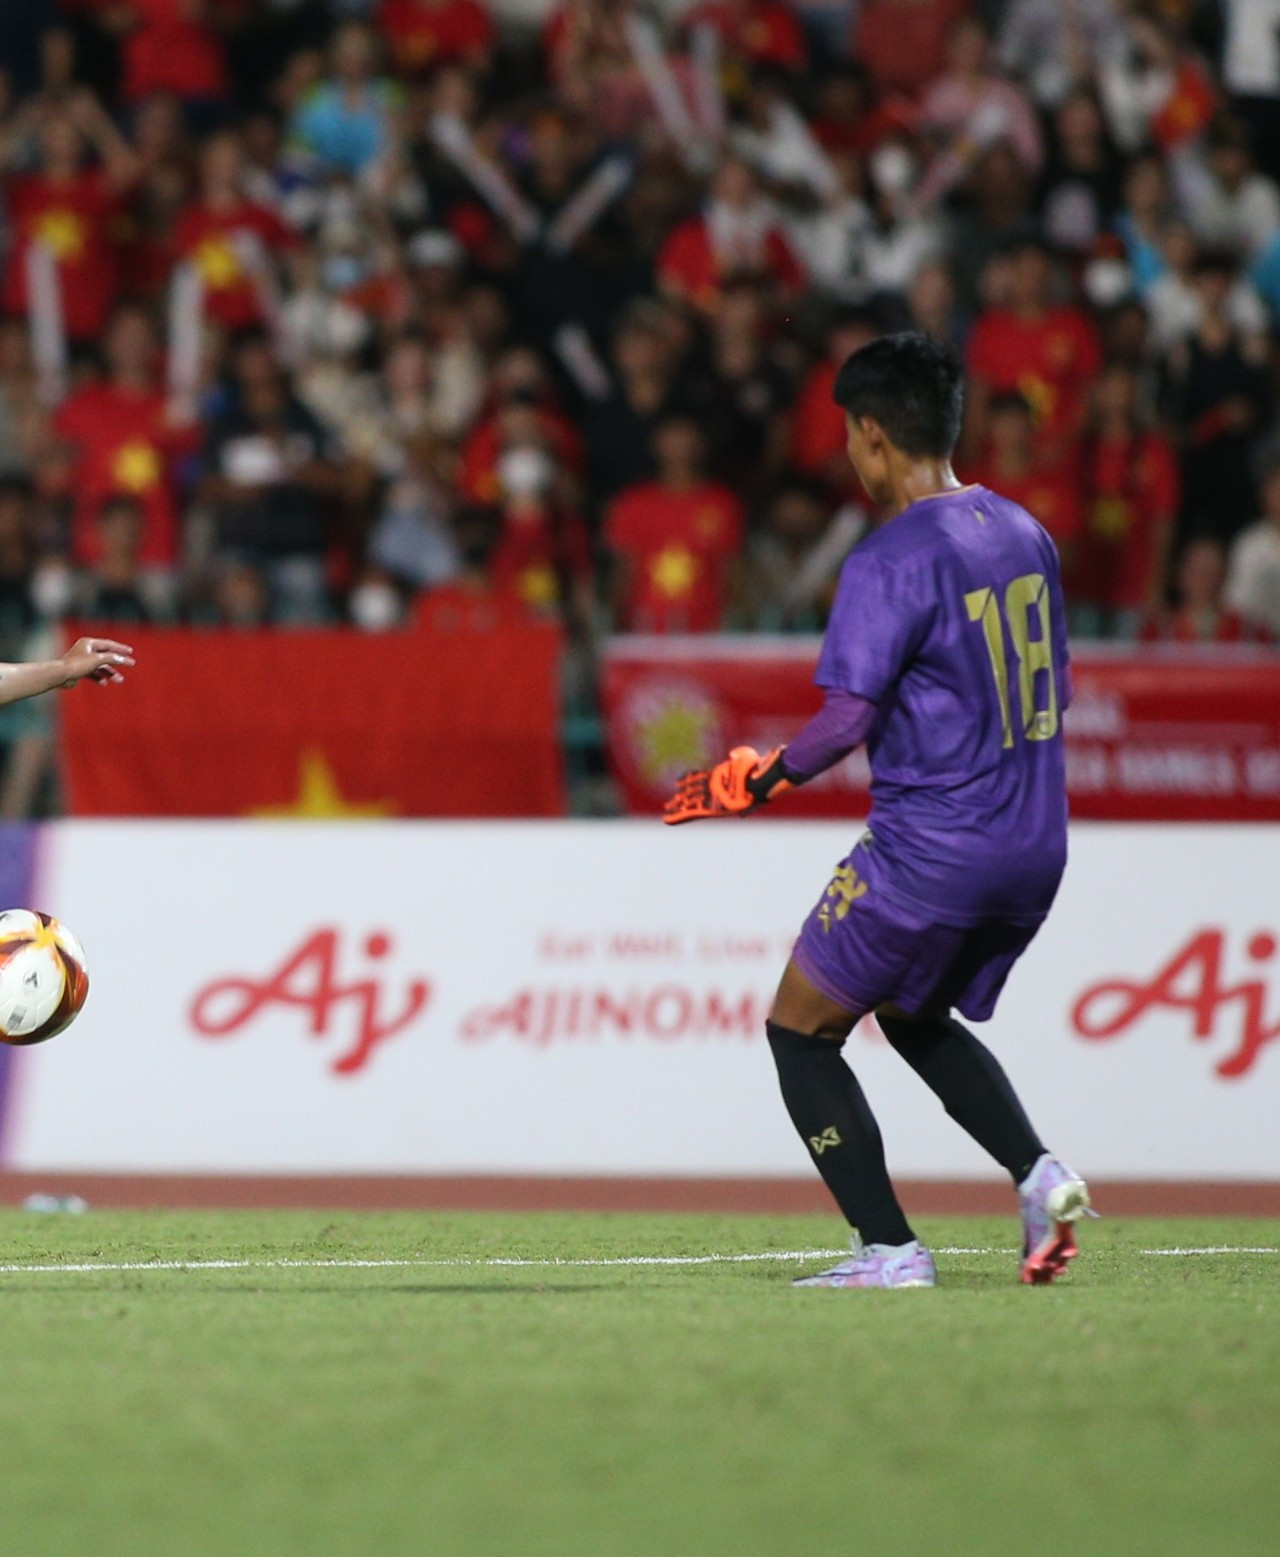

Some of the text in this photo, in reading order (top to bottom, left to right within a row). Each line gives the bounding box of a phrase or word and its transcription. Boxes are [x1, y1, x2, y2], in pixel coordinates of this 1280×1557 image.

[963, 573, 1058, 749] 18
[185, 925, 431, 1079] Aj
[1068, 925, 1280, 1079] Aj
